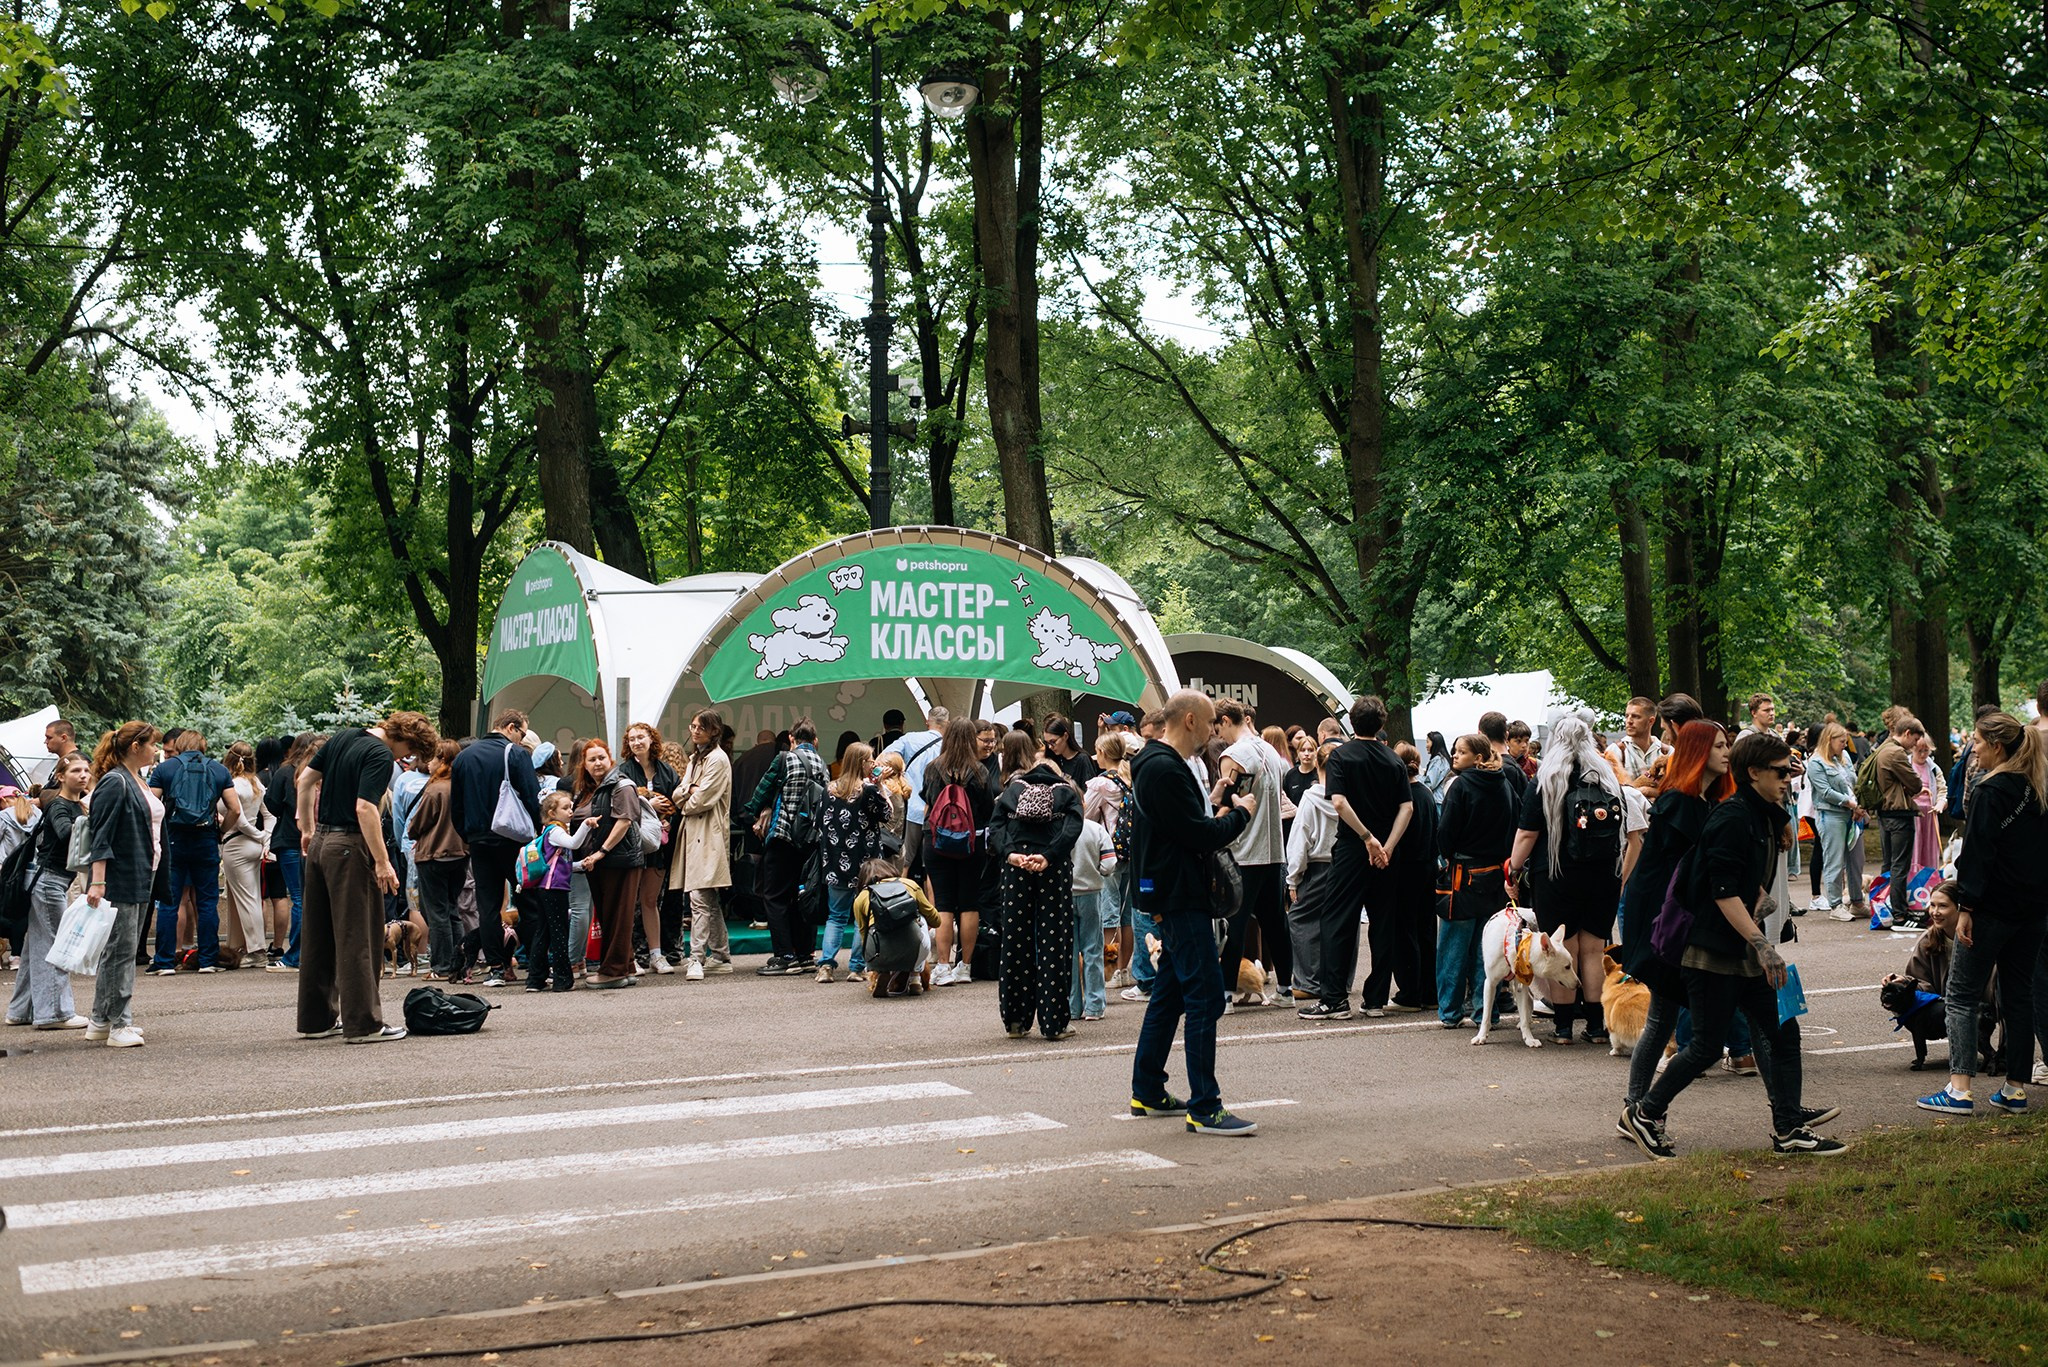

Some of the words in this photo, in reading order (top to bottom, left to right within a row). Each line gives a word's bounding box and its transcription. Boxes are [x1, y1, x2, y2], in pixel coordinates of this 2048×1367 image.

[910, 559, 968, 573] petshopru
[870, 580, 1009, 619] МАСТЕР-
[500, 602, 578, 653] МАСТЕР-КЛАССЫ
[871, 623, 1005, 661] КЛАССЫ
